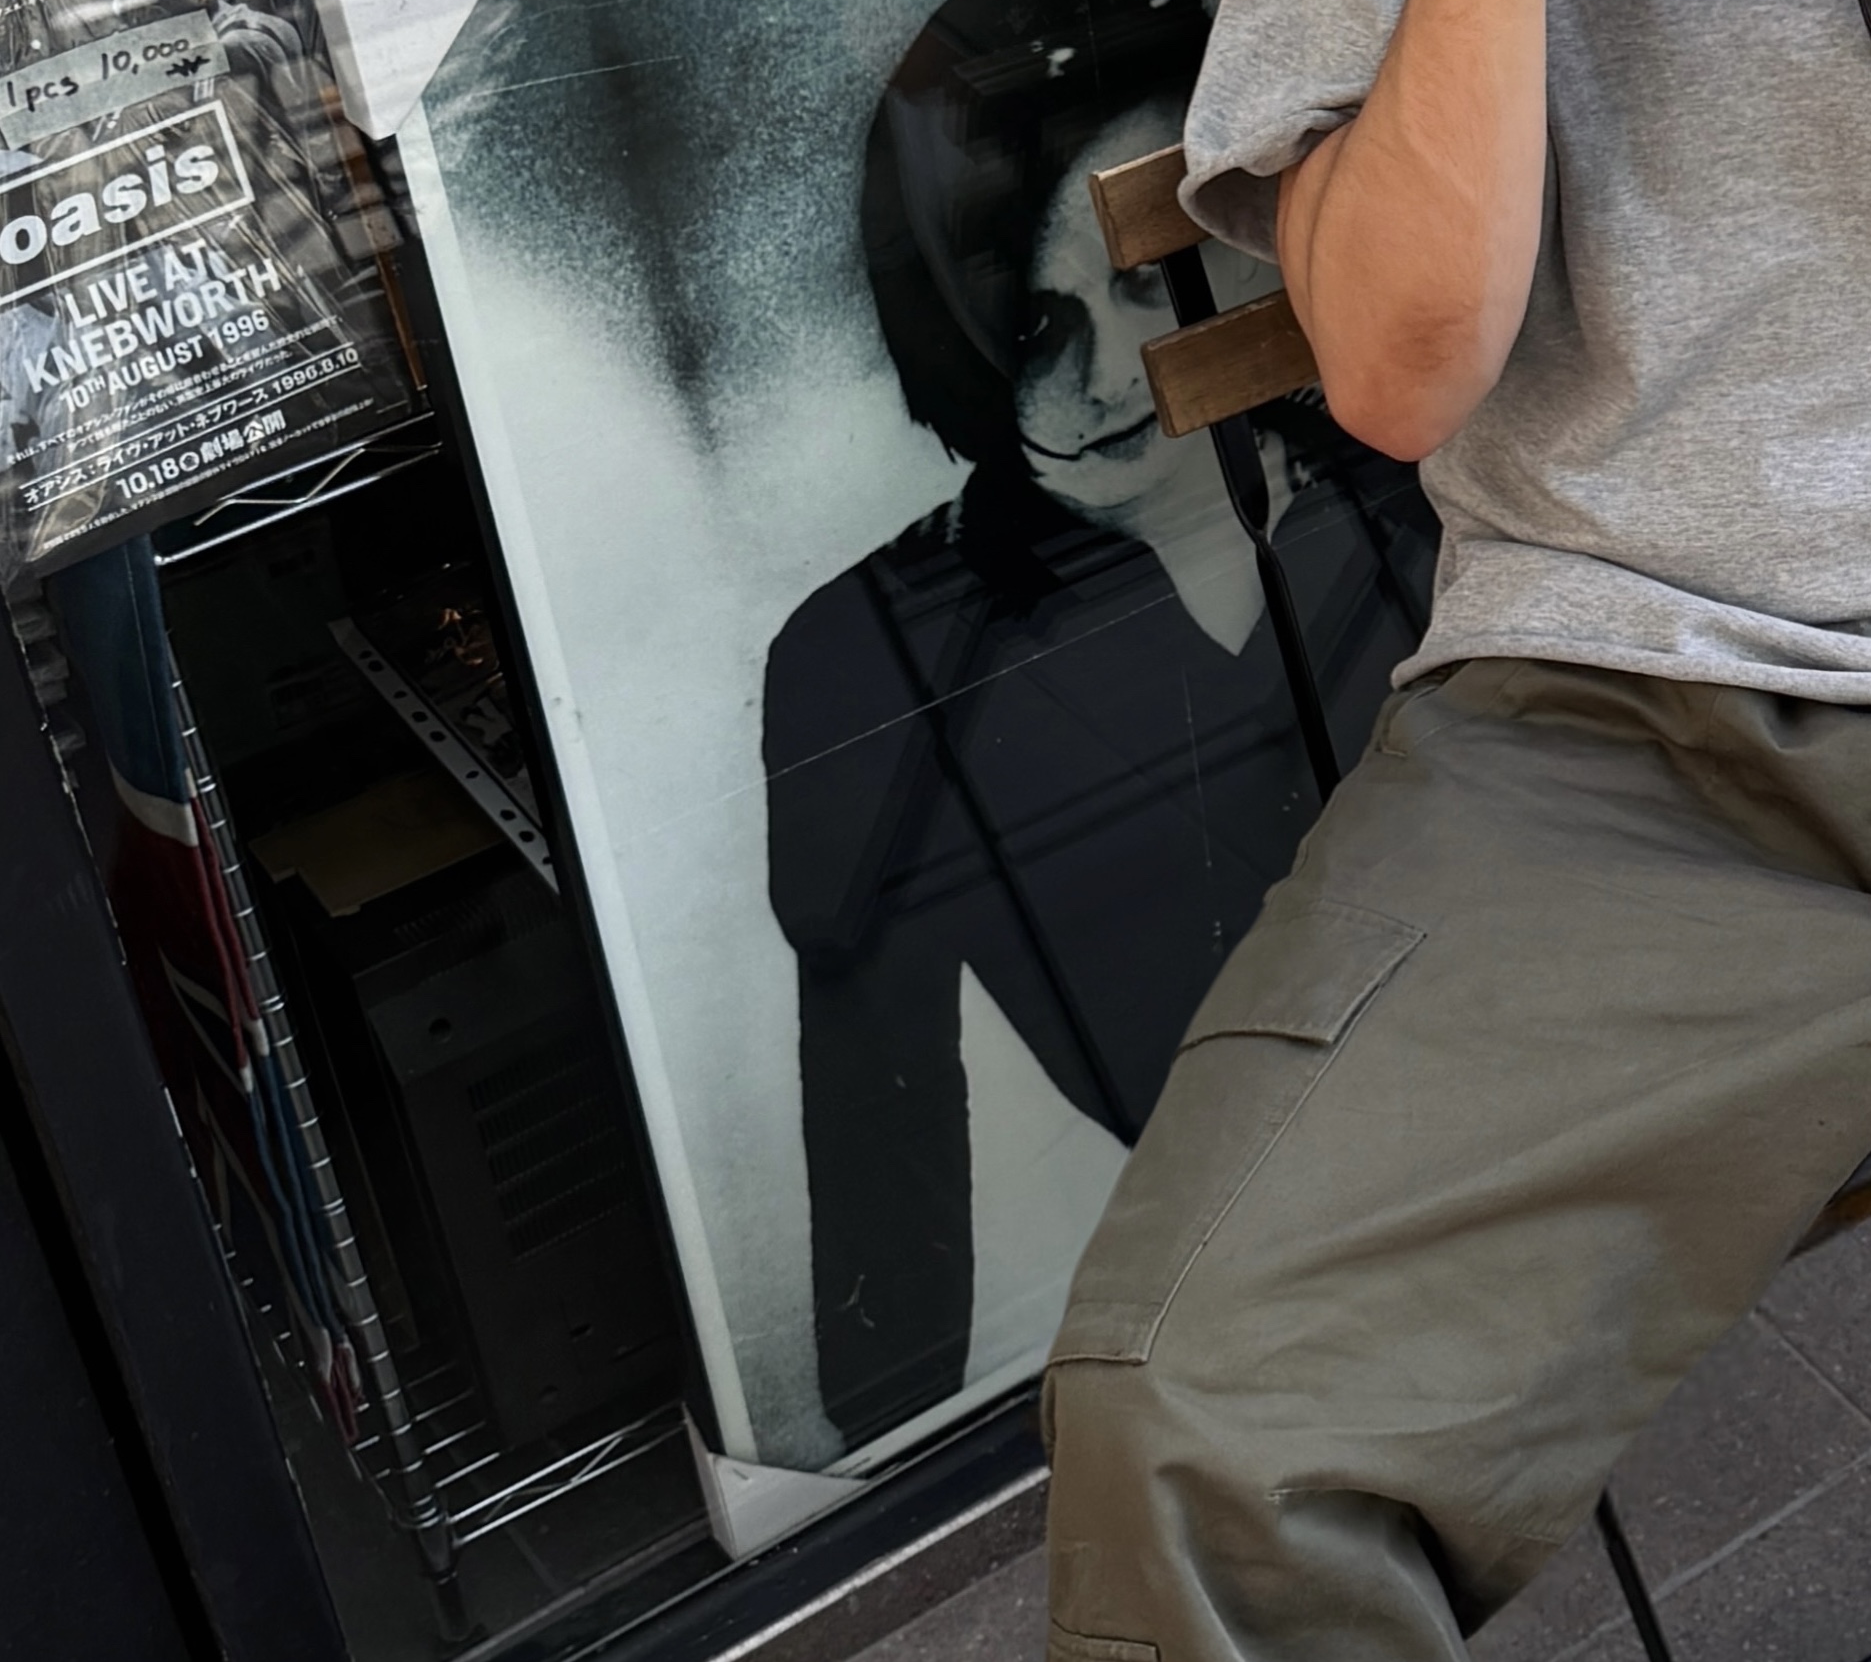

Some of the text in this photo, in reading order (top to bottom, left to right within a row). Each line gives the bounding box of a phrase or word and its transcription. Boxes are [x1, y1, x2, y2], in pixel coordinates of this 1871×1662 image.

[7, 81, 16, 107] 1
[25, 76, 79, 112] pcs
[101, 38, 189, 80] 10,000
[0, 144, 220, 265] oasis
[24, 257, 283, 394] KNEBWORTH
[65, 239, 212, 329] LIVE AT
[209, 308, 270, 352] 1996
